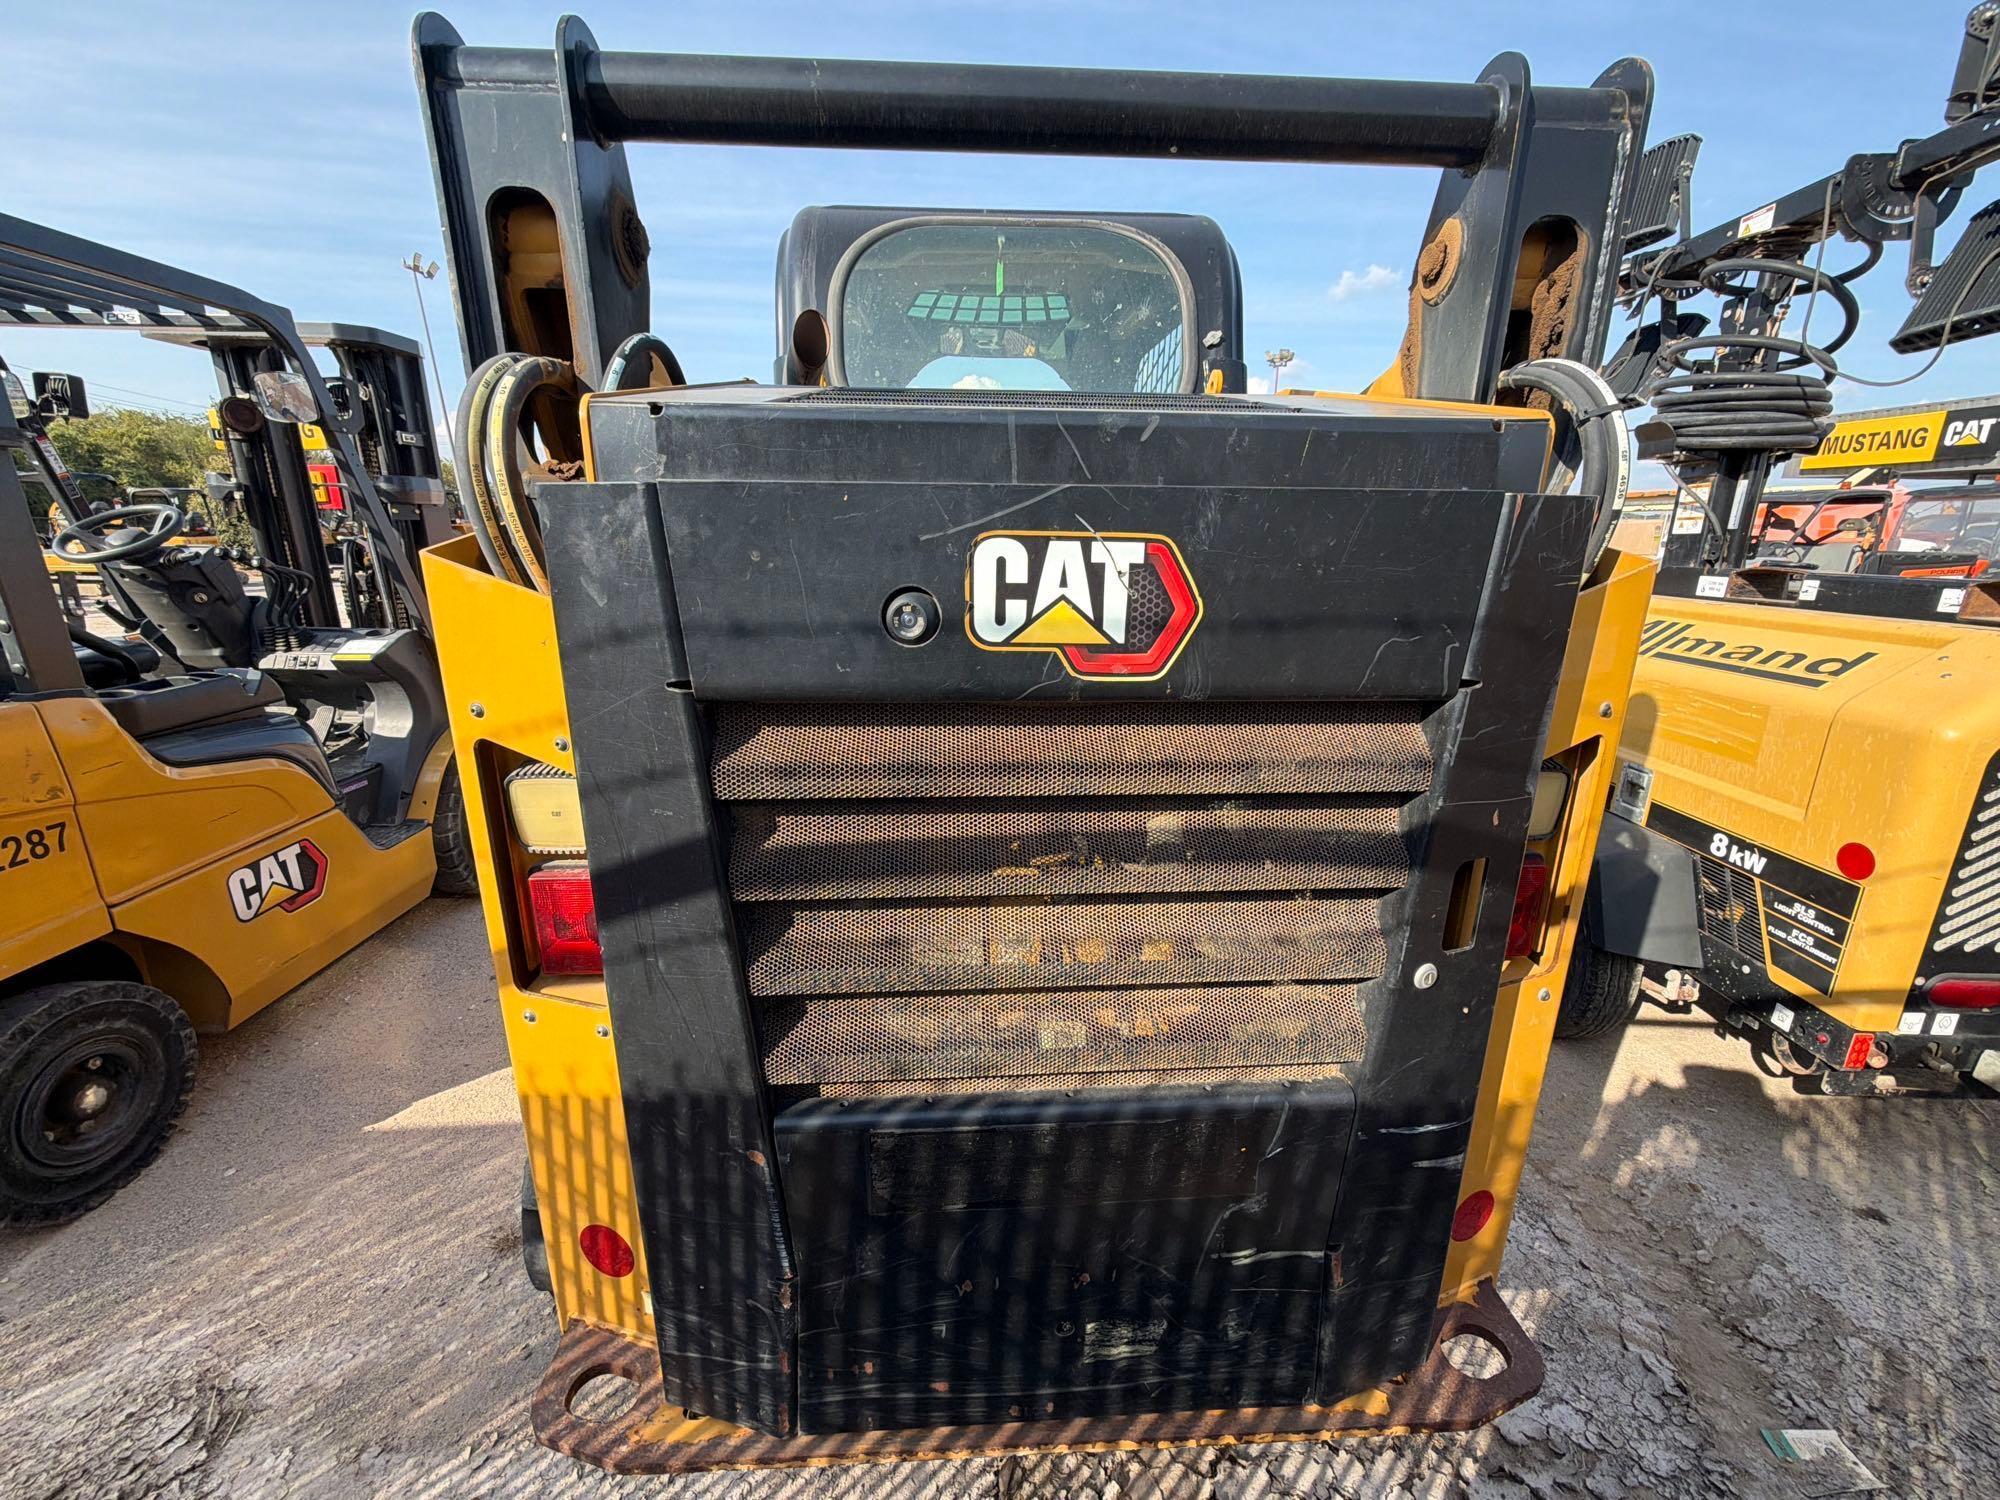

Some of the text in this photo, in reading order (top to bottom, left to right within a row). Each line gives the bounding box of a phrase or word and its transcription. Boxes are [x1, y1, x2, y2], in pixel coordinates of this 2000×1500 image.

[1822, 418, 1997, 455] MUSTANG CAT
[974, 537, 1145, 645] CAT
[0, 821, 67, 872] 287
[1709, 832, 1767, 875] 8 kW
[228, 843, 304, 922] CAT
[1774, 901, 1836, 937] LIGHT CONTROL
[1792, 902, 1816, 919] SLS
[1767, 925, 1788, 939] FLUID
[1791, 928, 1815, 946] FCS
